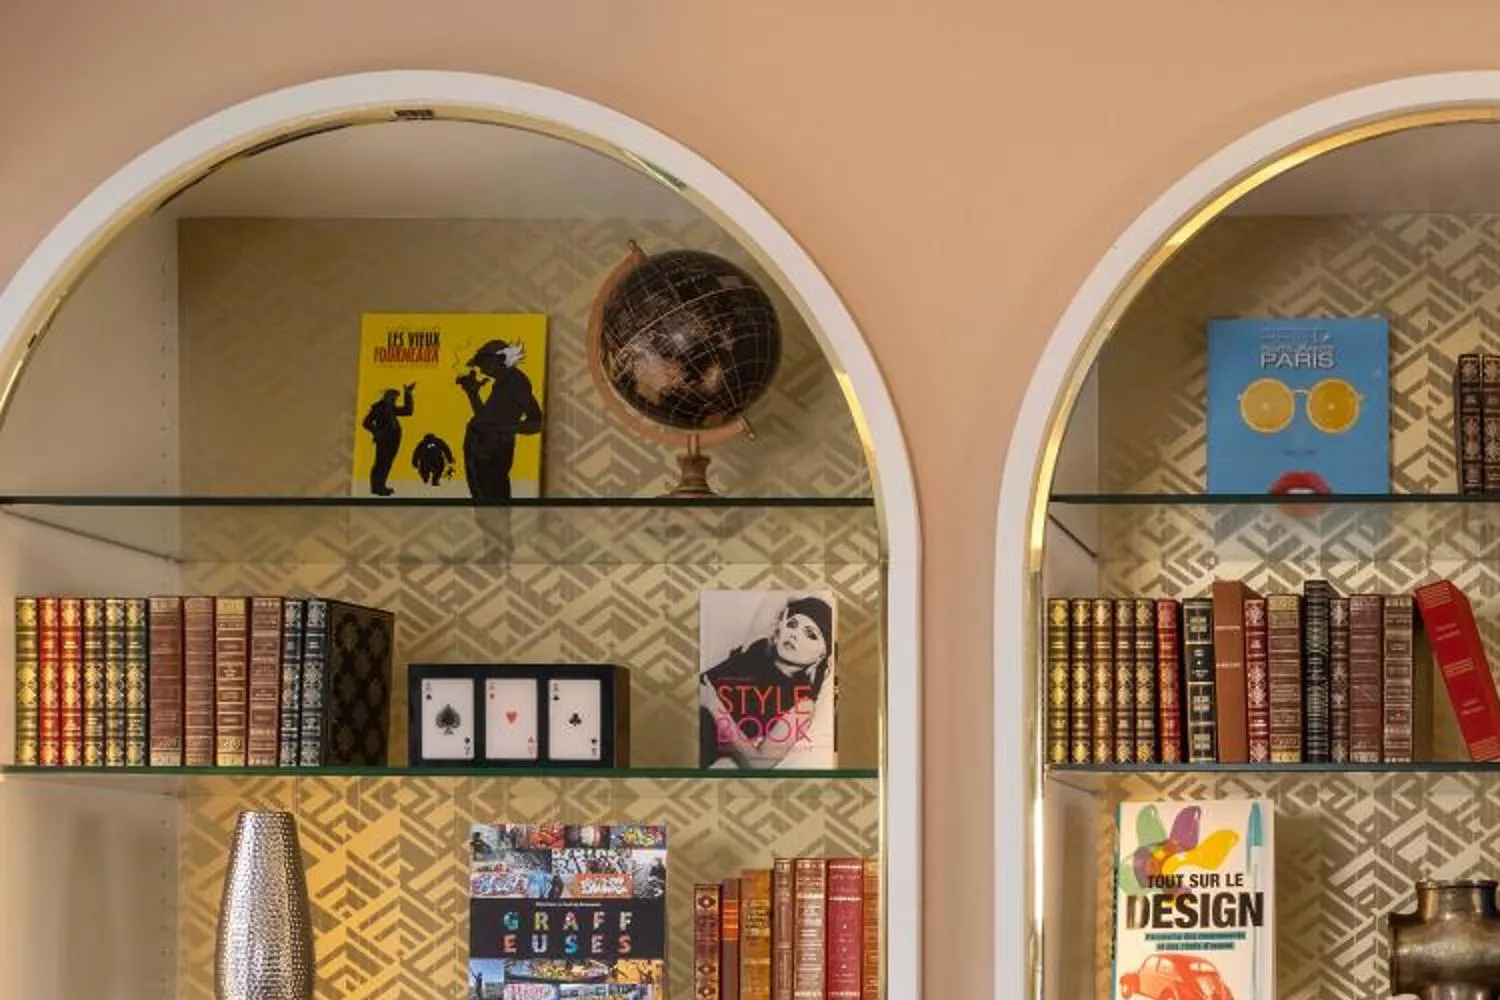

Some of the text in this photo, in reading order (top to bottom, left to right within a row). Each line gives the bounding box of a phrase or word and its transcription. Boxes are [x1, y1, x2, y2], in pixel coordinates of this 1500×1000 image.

[1261, 351, 1335, 369] PARIS
[717, 685, 813, 715] STYLE
[716, 716, 813, 743] BOOK
[1146, 873, 1244, 889] TOUT SUR LE
[1125, 891, 1265, 930] DESIGN
